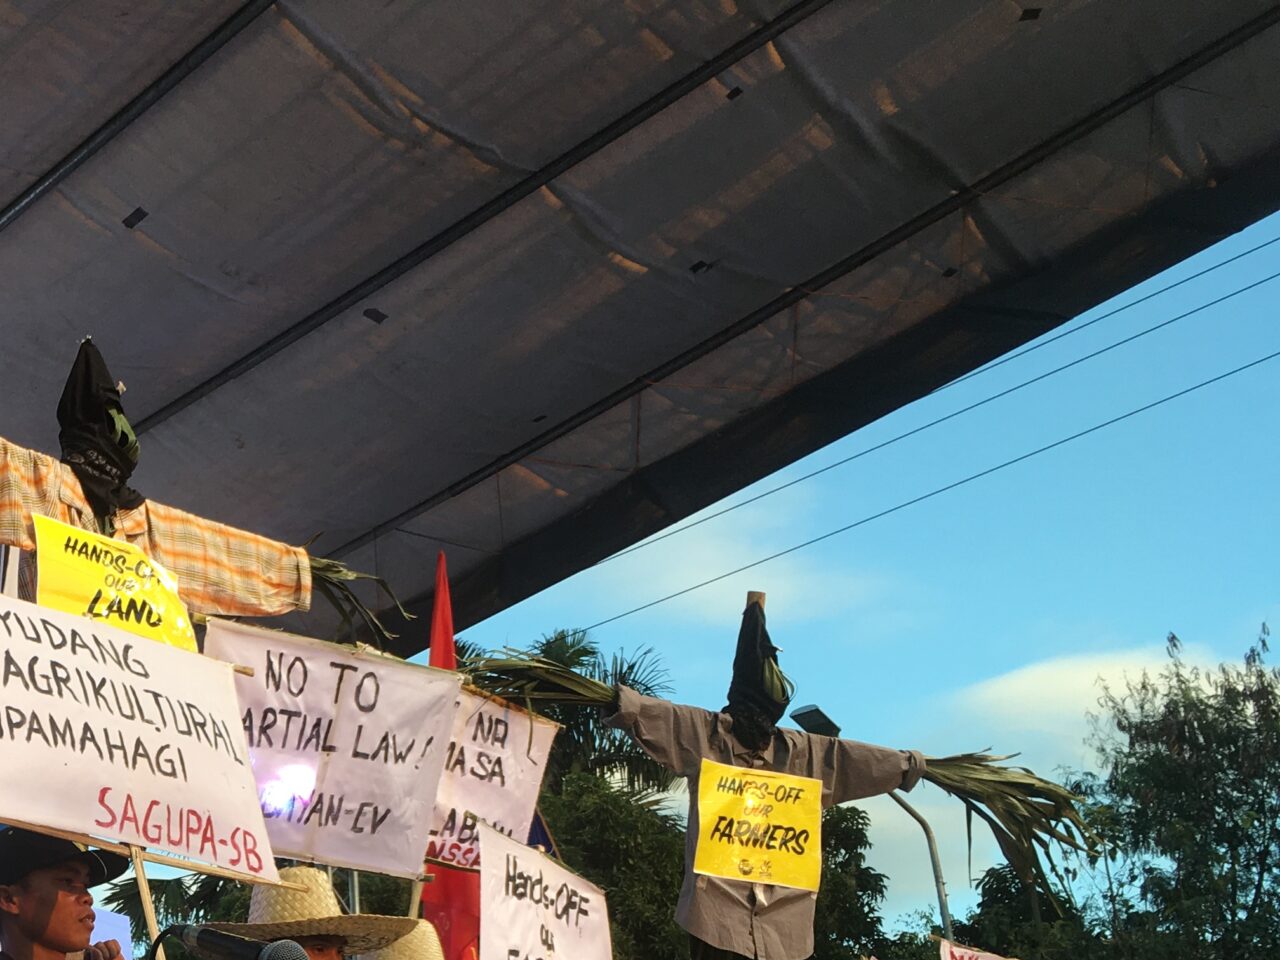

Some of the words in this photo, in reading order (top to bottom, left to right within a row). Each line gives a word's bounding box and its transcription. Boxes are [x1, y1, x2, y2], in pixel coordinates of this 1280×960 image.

[2, 648, 245, 766] AGRIKULTURAL
[265, 649, 308, 698] NO
[329, 661, 381, 714] TO
[242, 706, 337, 753] ARTIAL
[715, 775, 806, 806] HANDS-OFF
[94, 786, 264, 874] SAGUPA-SB
[709, 815, 810, 856] FARMERS
